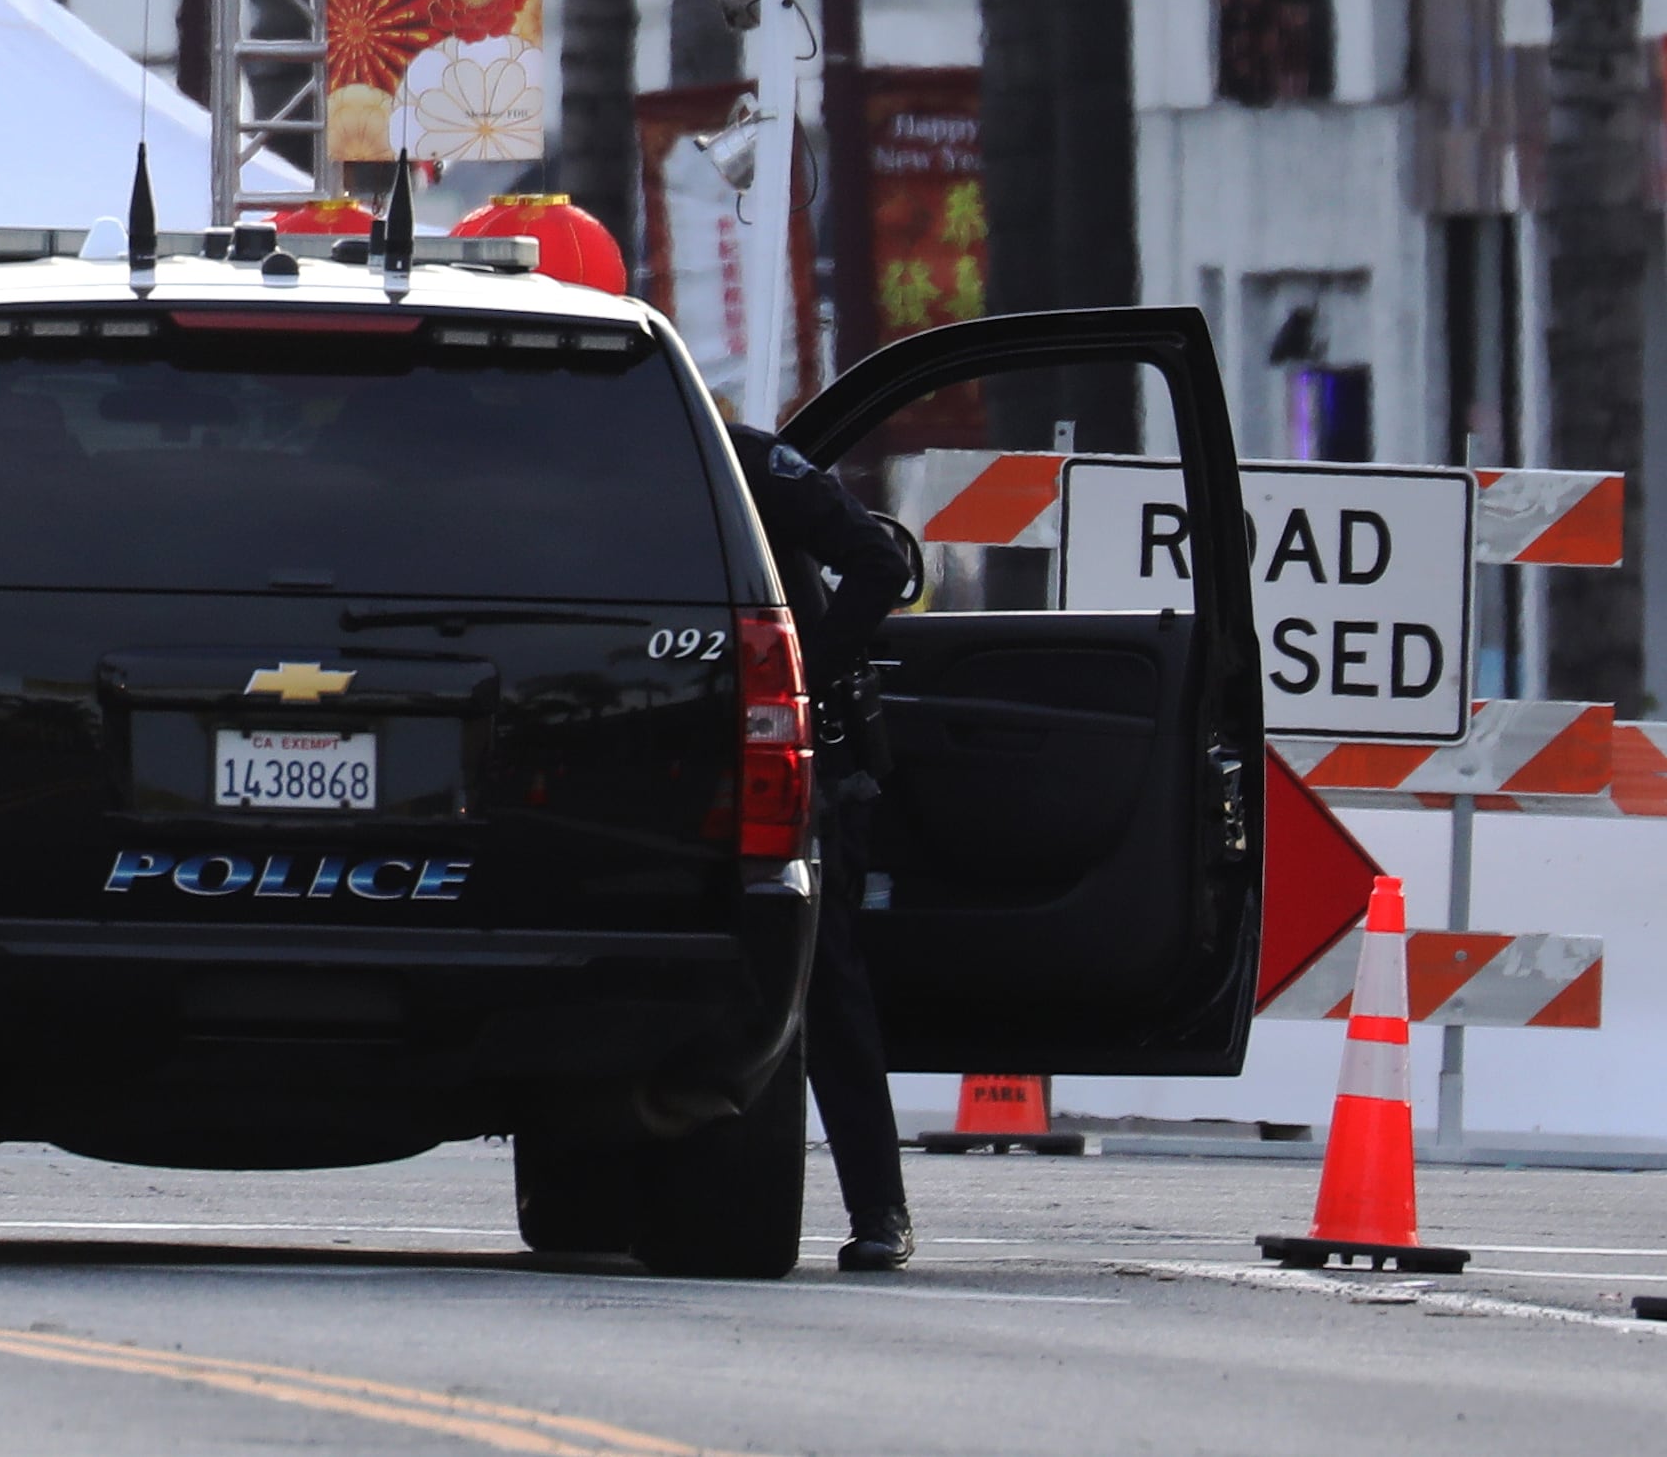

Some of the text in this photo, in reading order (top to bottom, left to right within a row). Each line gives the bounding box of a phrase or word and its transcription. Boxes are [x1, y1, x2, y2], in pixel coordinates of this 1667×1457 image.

[1140, 503, 1392, 585] RAD
[648, 628, 725, 661] 092
[252, 737, 339, 750] CA EXEMPT
[222, 758, 369, 800] 1438868
[103, 850, 472, 900] POLICE
